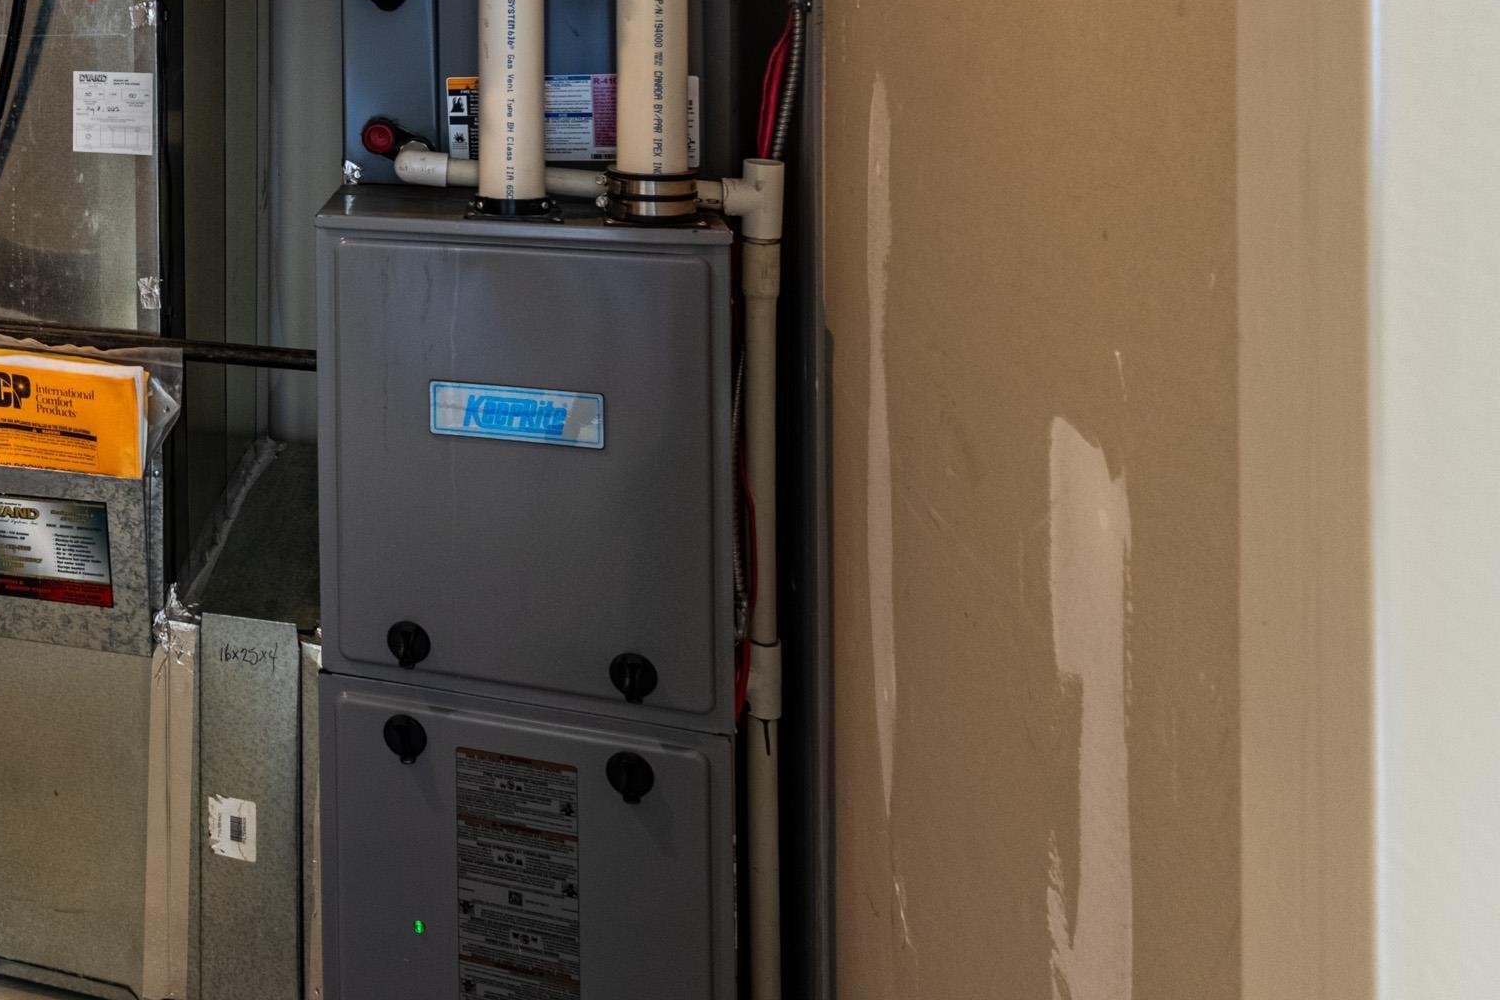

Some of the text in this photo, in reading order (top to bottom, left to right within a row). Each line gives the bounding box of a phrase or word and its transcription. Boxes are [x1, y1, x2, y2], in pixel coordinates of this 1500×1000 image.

[506, 54, 515, 69] Gas
[506, 74, 515, 93] Vent
[654, 70, 664, 100] CANADA
[506, 136, 515, 161] Class
[653, 138, 663, 158] IPEX
[35, 383, 95, 400] International
[35, 394, 73, 408] Comfort
[36, 404, 77, 418] Products
